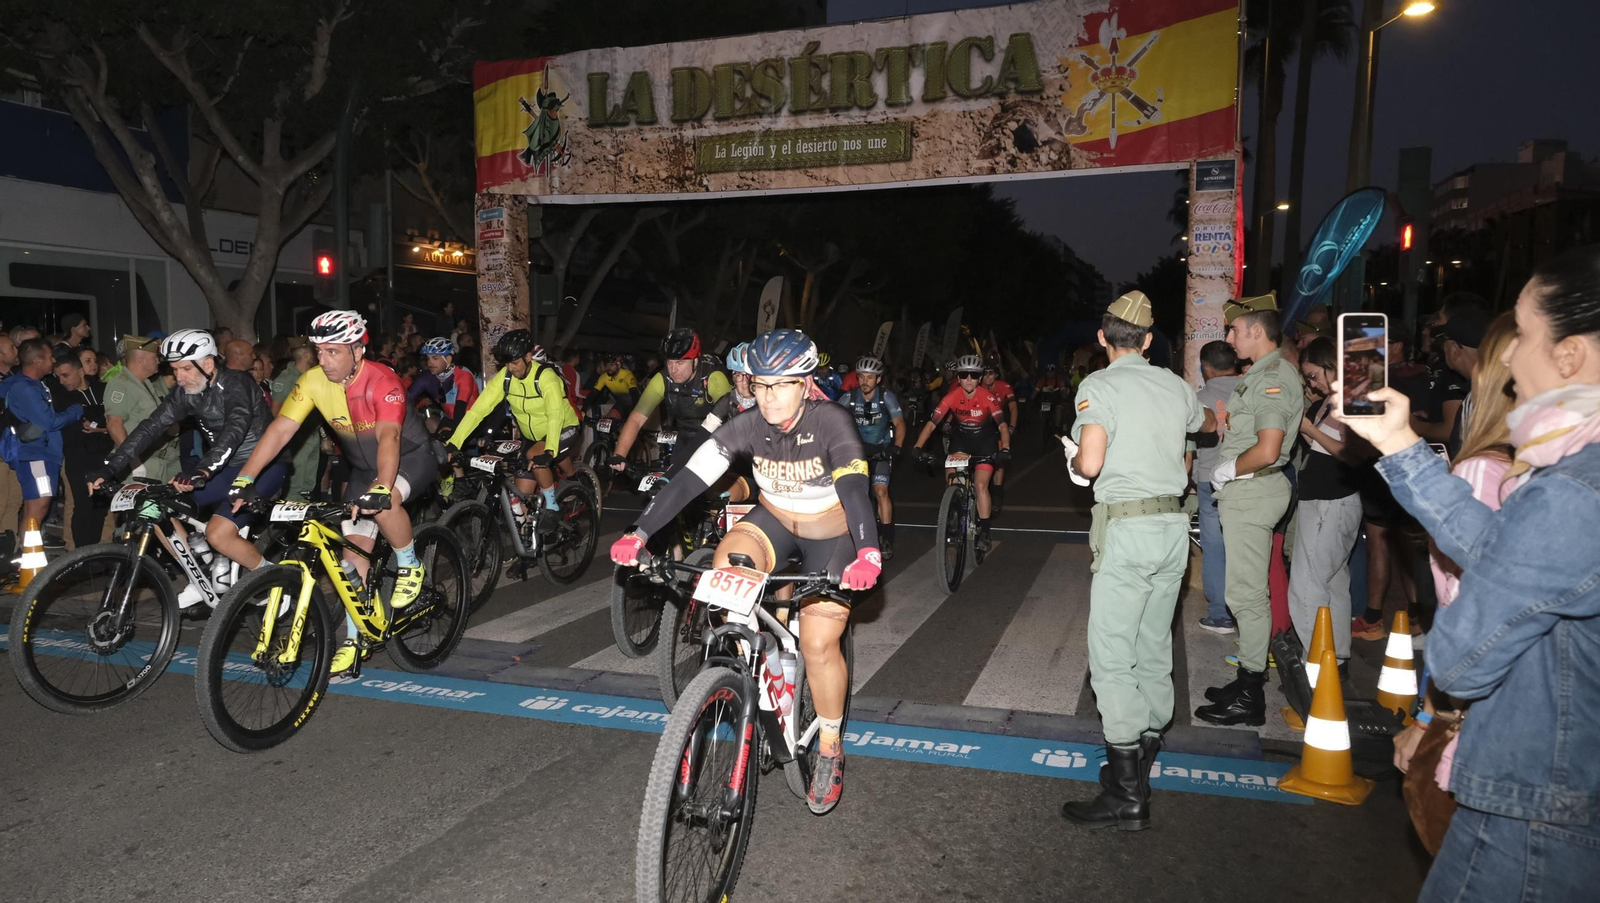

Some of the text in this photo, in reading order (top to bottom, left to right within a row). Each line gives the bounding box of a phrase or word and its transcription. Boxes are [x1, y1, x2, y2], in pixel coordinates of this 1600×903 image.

[587, 32, 1044, 128] LA DESÉRTICA
[715, 136, 887, 160] La Legión y el desierto nos une
[1195, 232, 1231, 242] RENTA
[482, 283, 502, 291] BBVA
[1191, 331, 1226, 340] primaflo
[753, 456, 825, 482] TABERNAS
[173, 539, 215, 603] ORBEA
[710, 571, 757, 599] 8517
[22, 599, 37, 643] MAXXIS
[410, 604, 436, 620] SCOTT
[361, 679, 486, 701] cajamar
[293, 691, 319, 728] MAXXIS
[571, 704, 671, 722] cajam
[843, 731, 981, 754] ajamar
[891, 747, 972, 760] CAJA RURAL
[1149, 761, 1278, 787] jamar
[1191, 778, 1229, 788] CAJA
